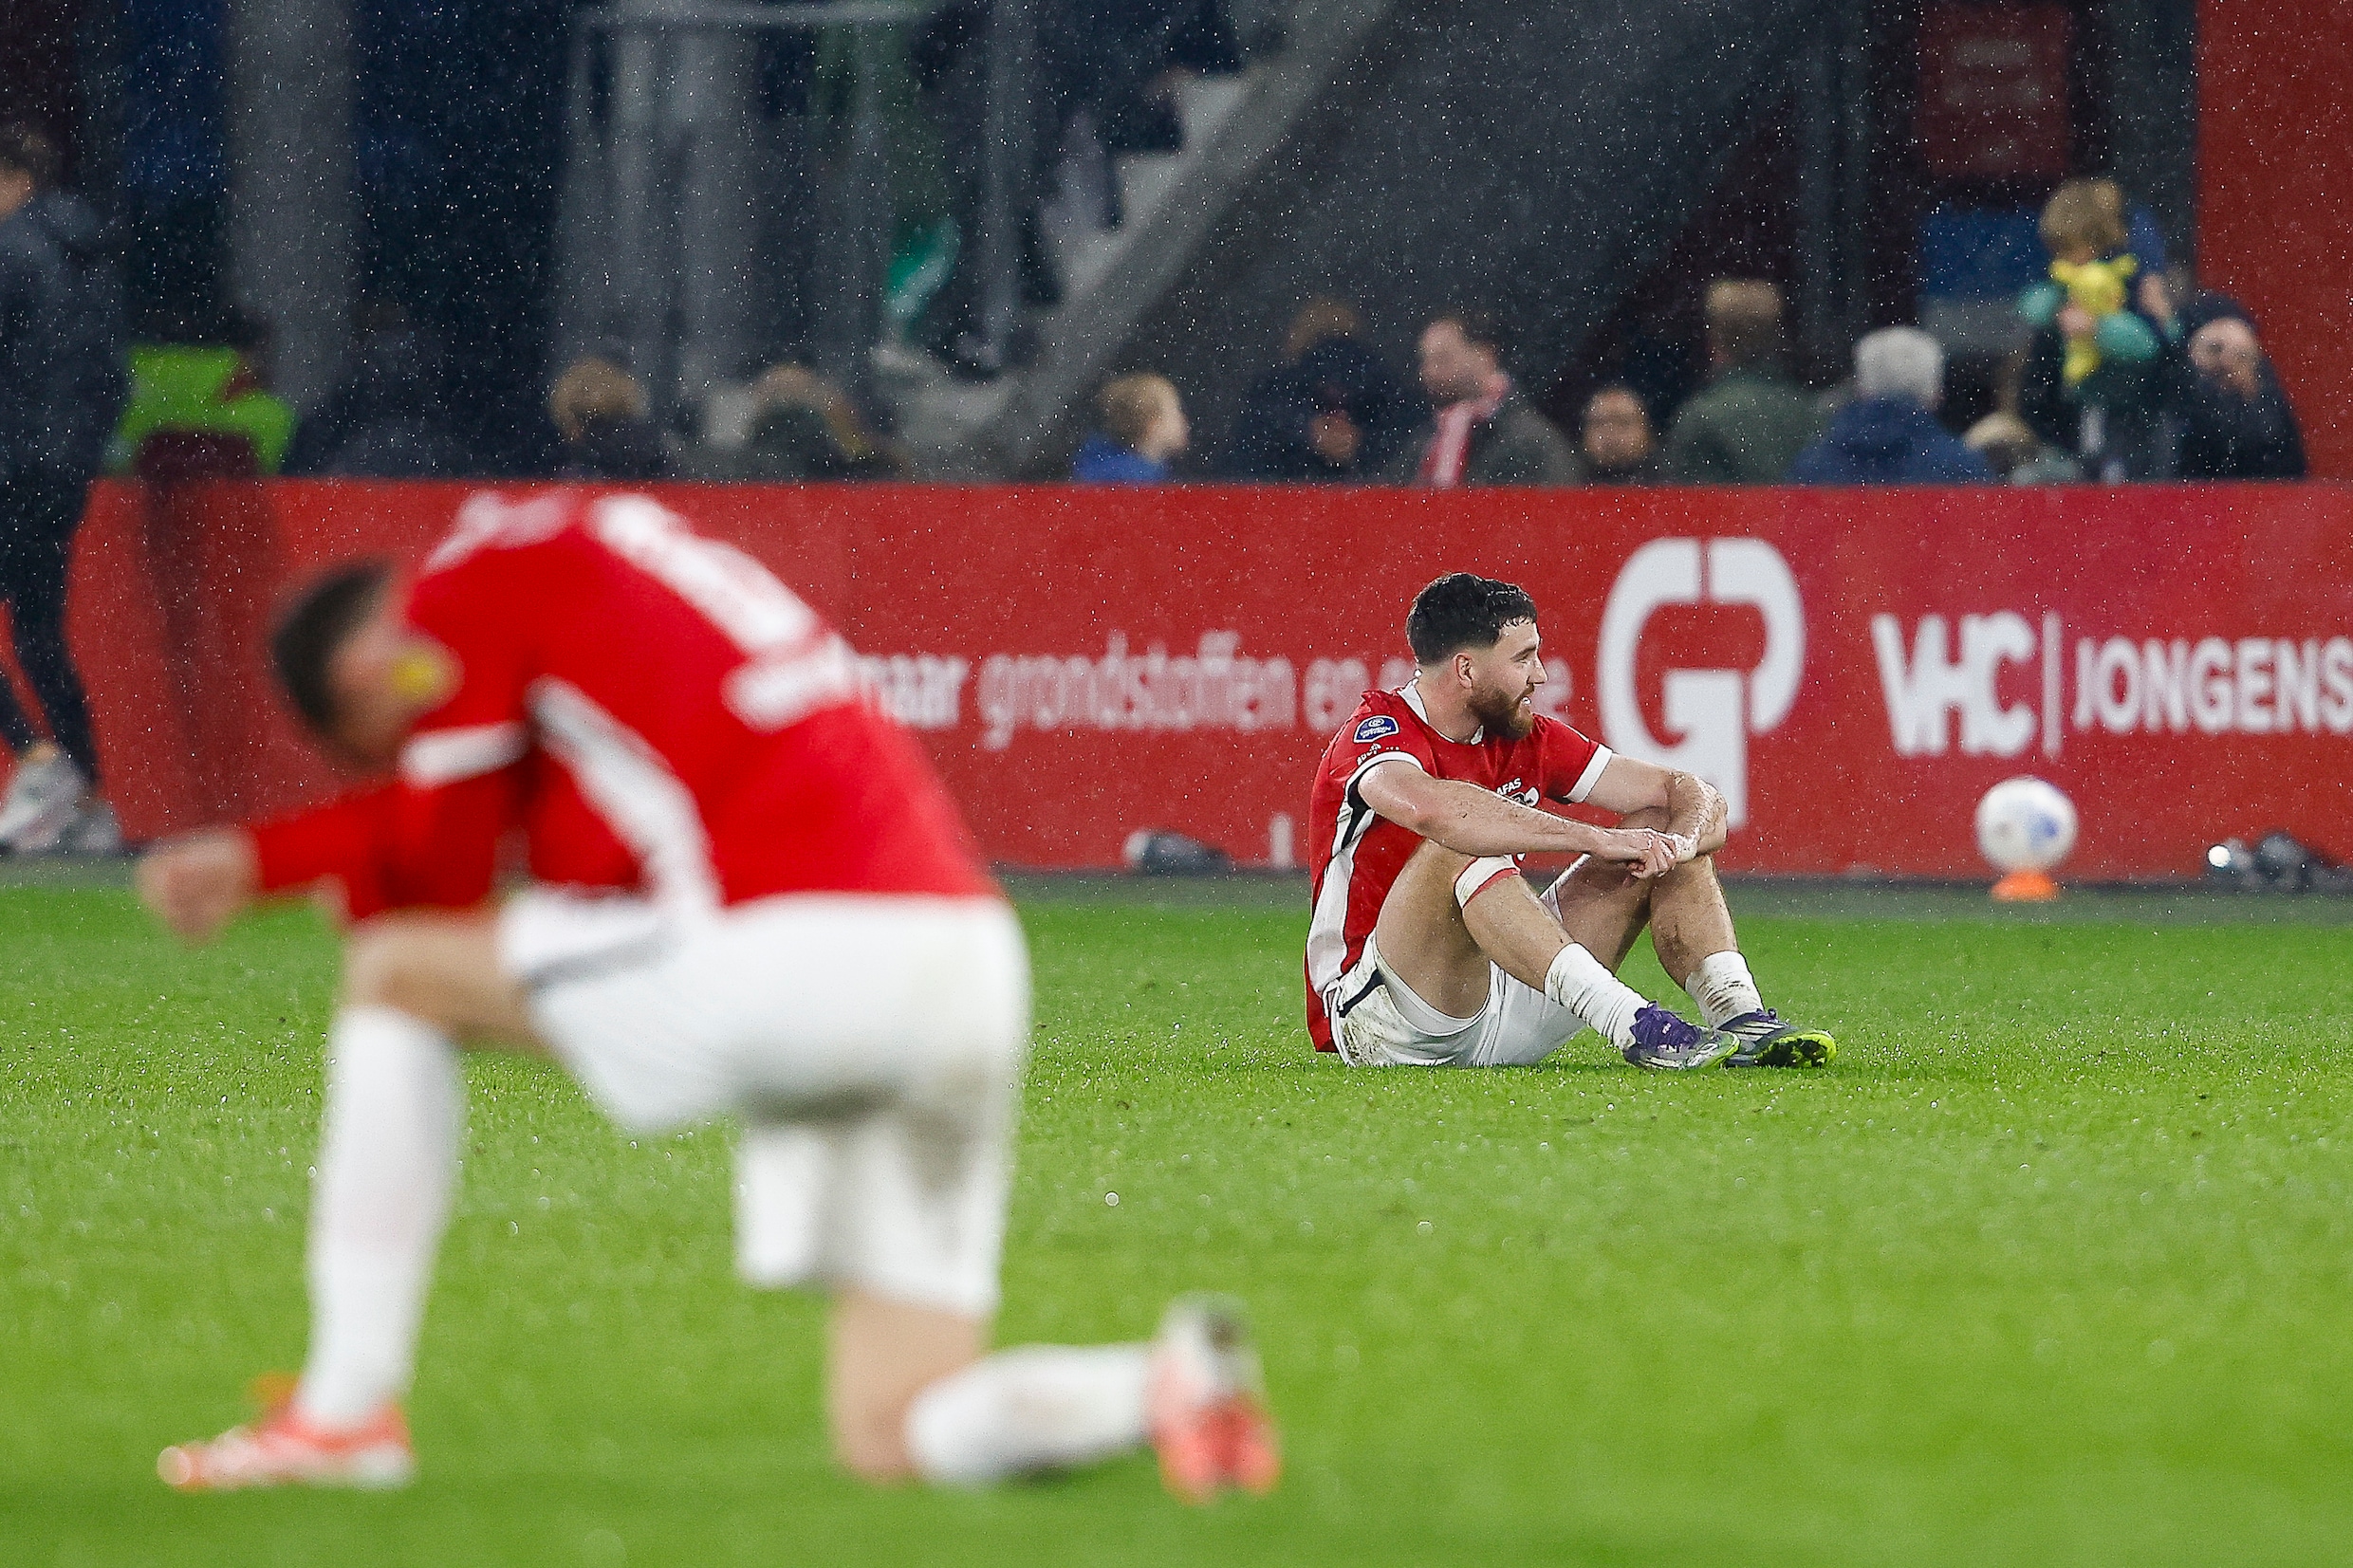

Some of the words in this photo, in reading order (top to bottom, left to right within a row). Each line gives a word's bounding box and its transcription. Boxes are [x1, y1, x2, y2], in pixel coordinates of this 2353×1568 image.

[977, 628, 1298, 752] grondstoffen
[1870, 610, 2035, 758] VHC
[2072, 634, 2353, 735] JONGENS
[1496, 777, 1522, 796] AFAS
